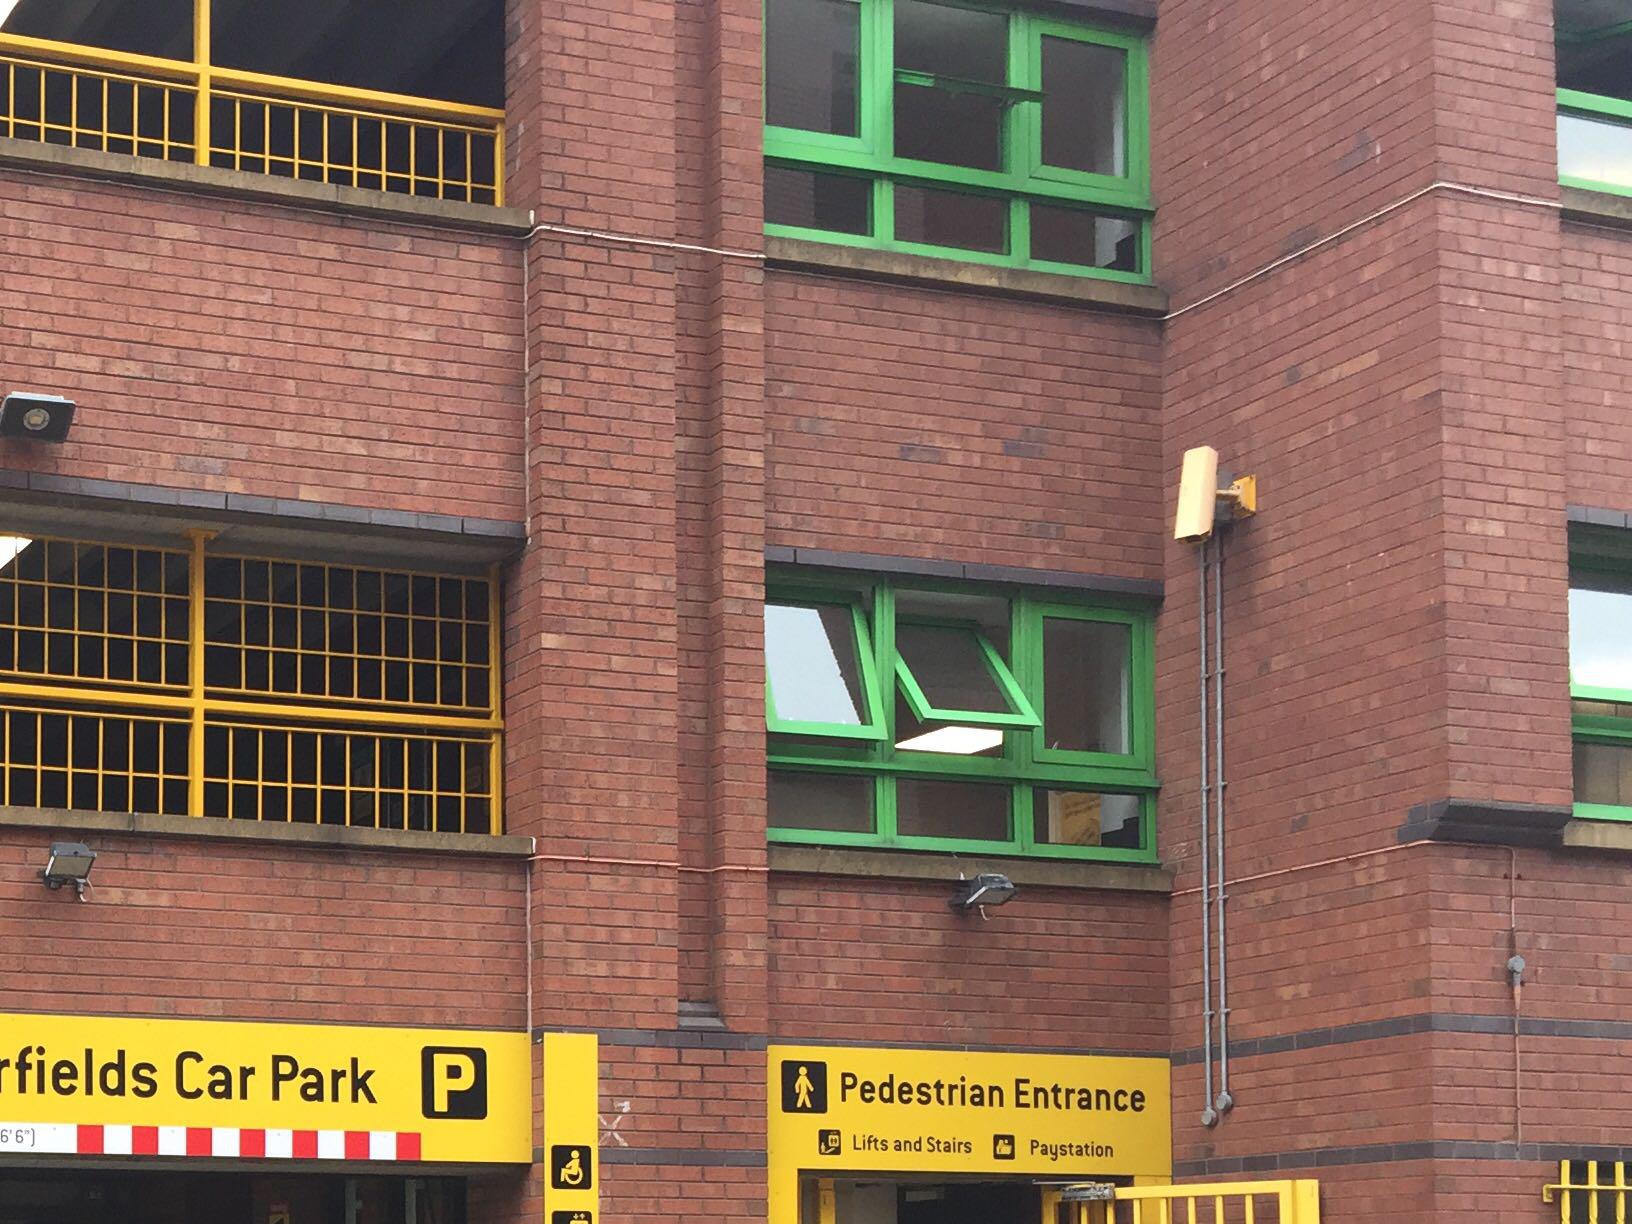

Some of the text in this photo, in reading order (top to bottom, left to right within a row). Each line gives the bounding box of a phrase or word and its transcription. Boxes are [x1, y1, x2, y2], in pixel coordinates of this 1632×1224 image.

[175, 1052, 256, 1101] Car
[272, 1054, 377, 1104] Park
[434, 1052, 477, 1114] P
[841, 1072, 1145, 1112] Pedestrian Entrance
[853, 1135, 972, 1154] Lifts and Stairs
[1031, 1140, 1113, 1160] Paystation
